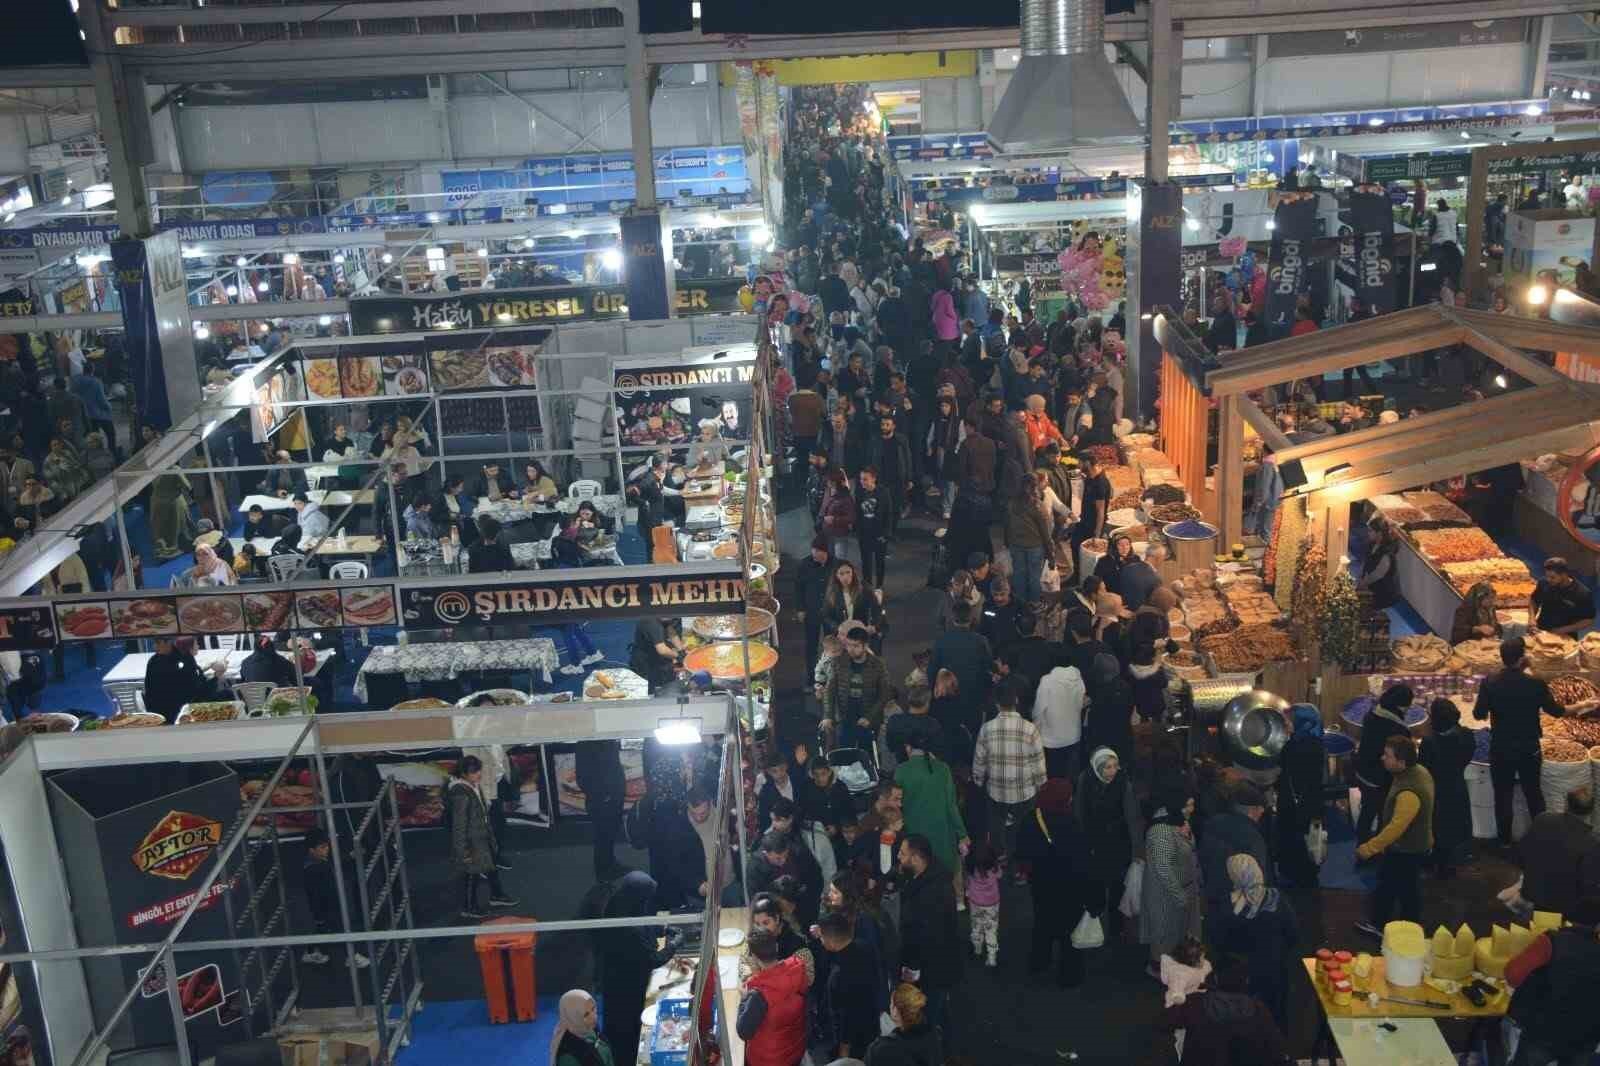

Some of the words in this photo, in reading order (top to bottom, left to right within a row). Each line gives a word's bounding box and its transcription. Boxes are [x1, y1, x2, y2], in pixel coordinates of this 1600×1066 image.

[33, 230, 104, 246] DİYARBAKIR
[221, 223, 256, 239] ODASI
[1275, 239, 1301, 294] bingöl
[479, 297, 584, 322] YÖRESEL
[474, 583, 640, 621] ŞIRDANCI
[133, 904, 165, 926] BİNGÖL
[164, 902, 175, 913] ET
